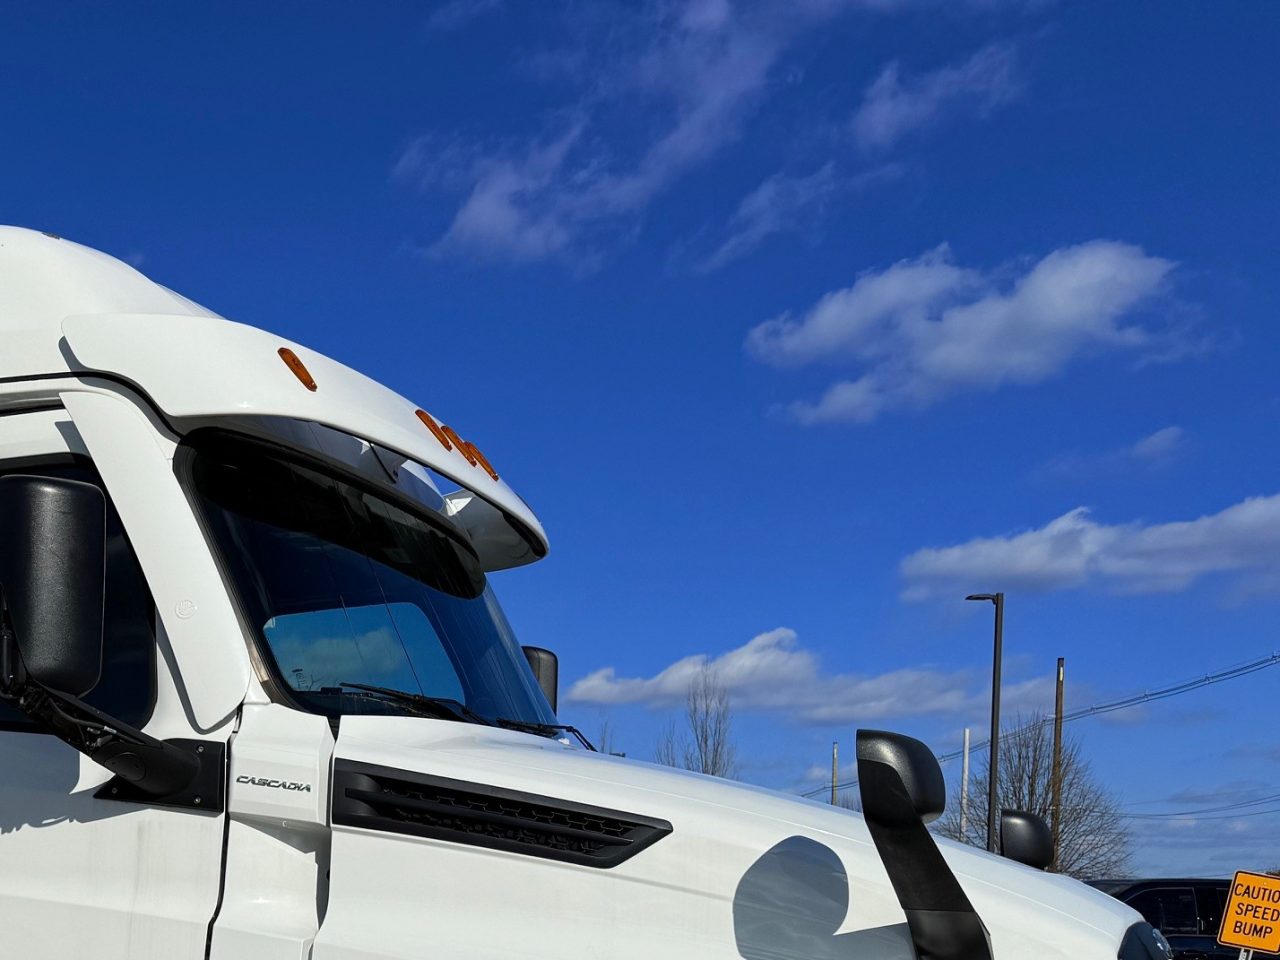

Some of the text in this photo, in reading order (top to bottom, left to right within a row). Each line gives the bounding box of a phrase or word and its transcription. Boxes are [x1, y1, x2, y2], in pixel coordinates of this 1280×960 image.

[236, 775, 311, 792] CASCADIA
[1234, 883, 1280, 903] CAUTIO
[1235, 902, 1280, 922] SPEED
[1233, 920, 1273, 938] BUMP
